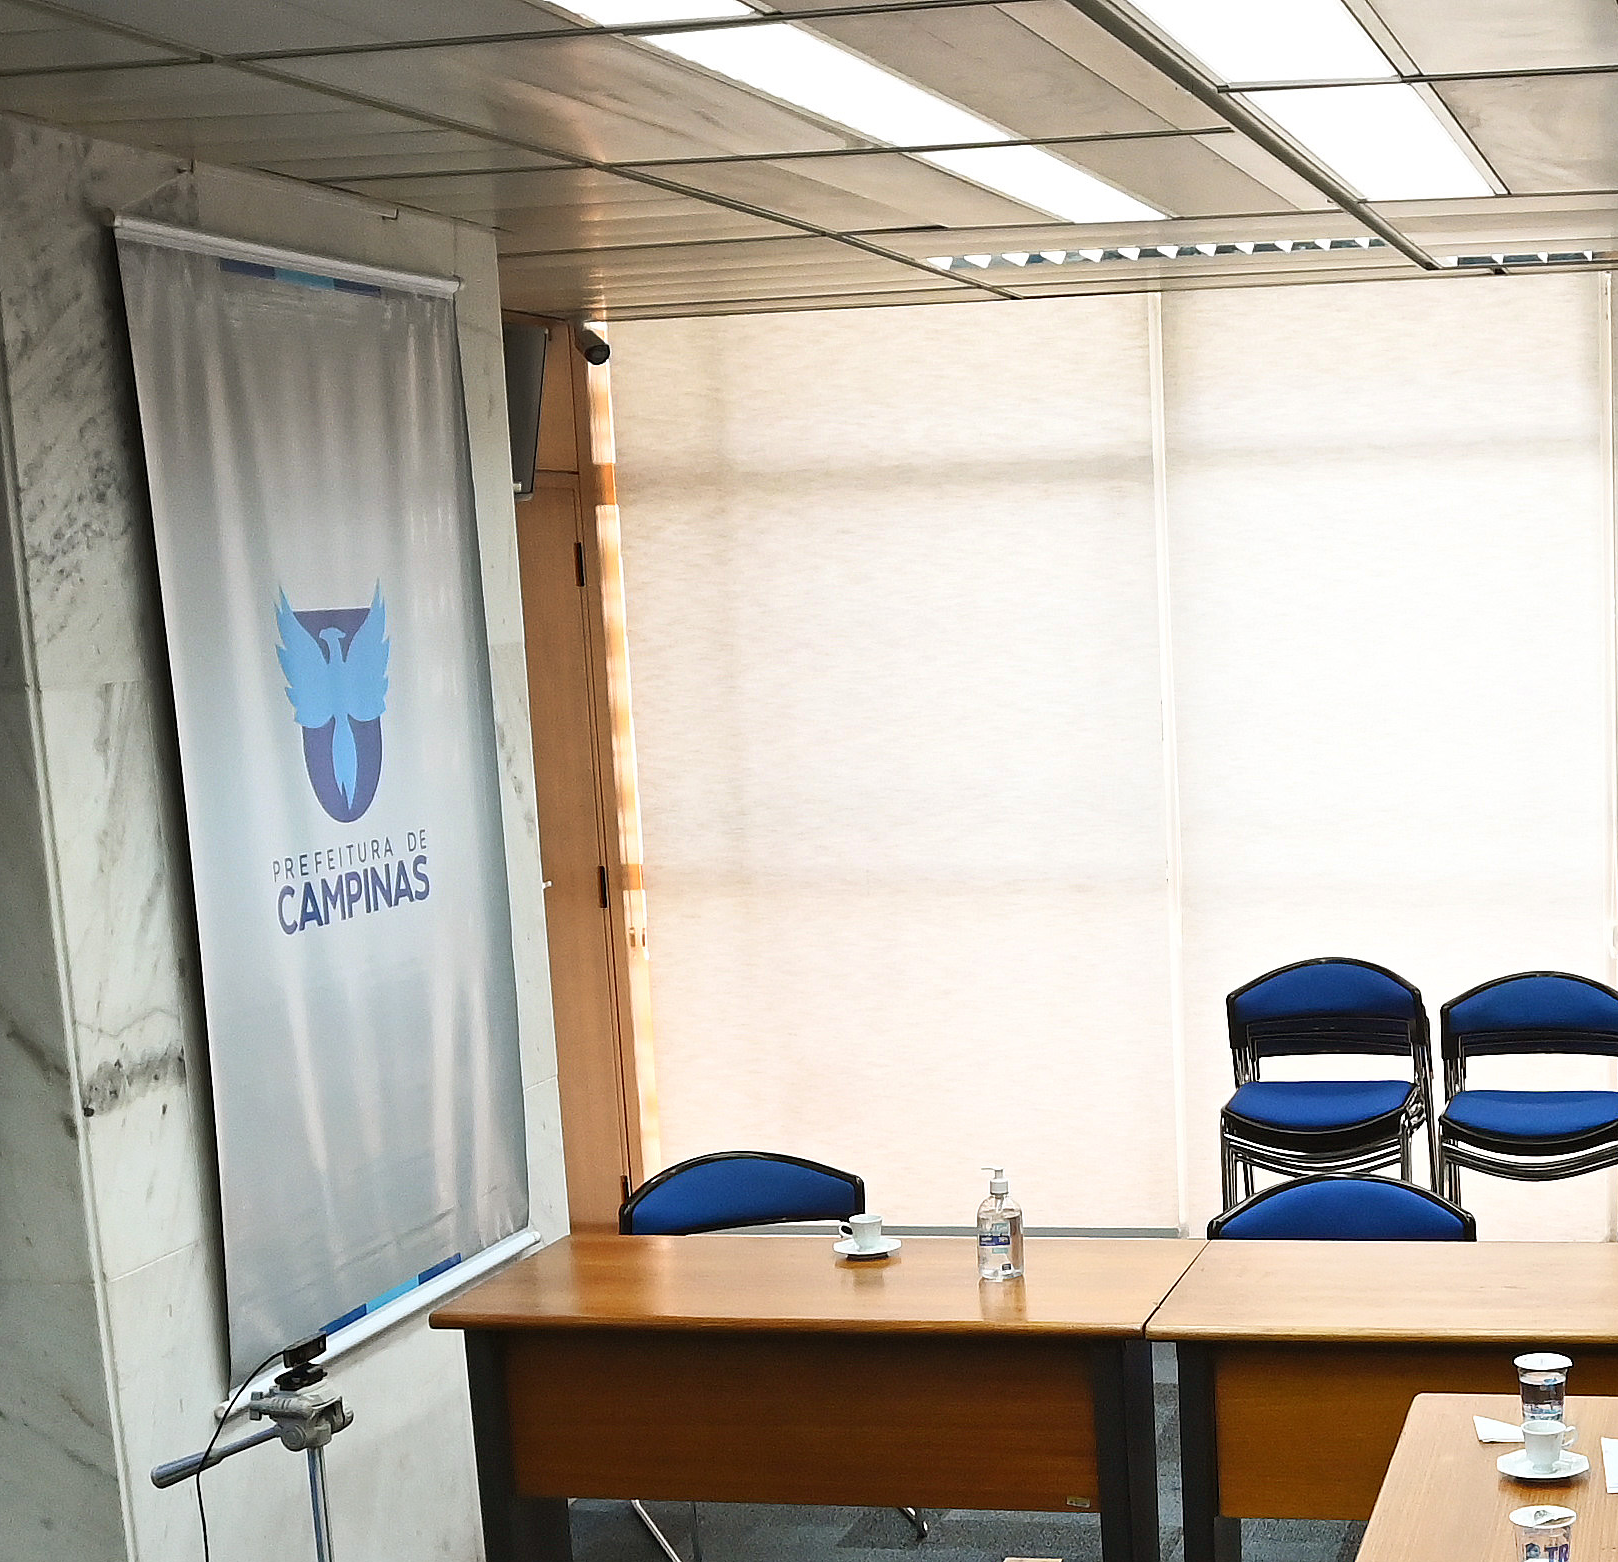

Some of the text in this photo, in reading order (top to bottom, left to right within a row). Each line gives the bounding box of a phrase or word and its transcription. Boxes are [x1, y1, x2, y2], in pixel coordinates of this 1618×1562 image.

[272, 829, 427, 882] PREFEITURA DE
[277, 854, 430, 935] CAMPINAS
